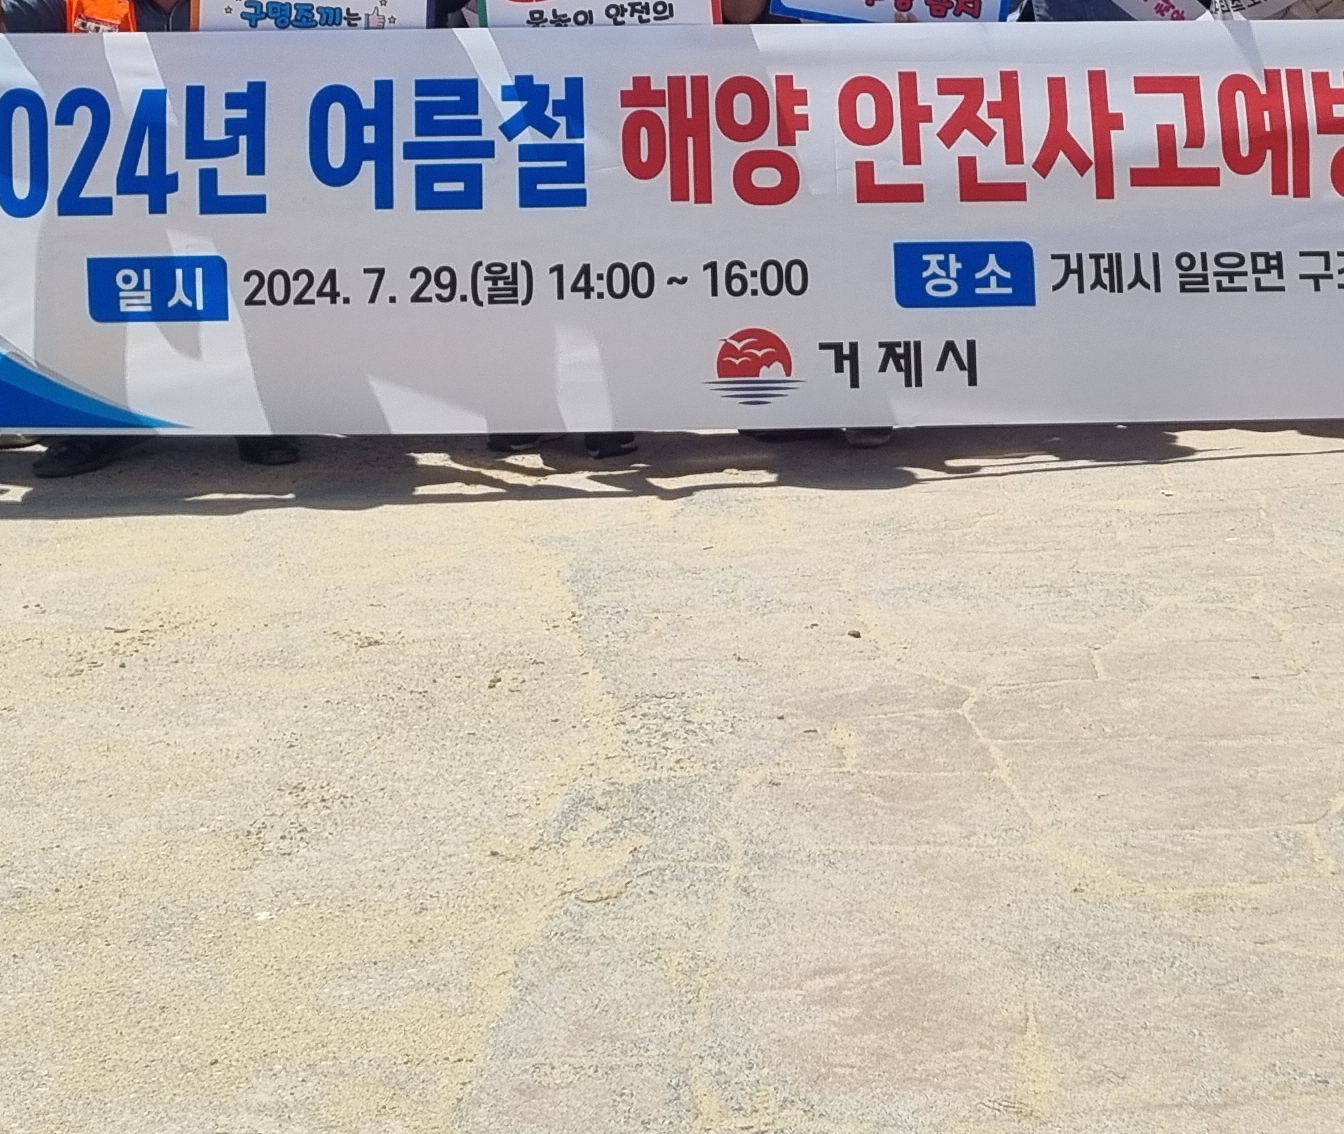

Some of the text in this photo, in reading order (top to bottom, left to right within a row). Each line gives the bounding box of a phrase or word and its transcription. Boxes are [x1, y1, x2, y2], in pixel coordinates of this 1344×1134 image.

[604, 0, 674, 26] 안전의
[309, 74, 588, 210] 여름철
[621, 74, 809, 205] 해양
[243, 268, 350, 307] 2024.
[364, 267, 397, 305] 7.
[409, 259, 534, 306] 29.(월)
[548, 261, 655, 301] 14:00
[703, 259, 808, 299] 16:00
[1050, 252, 1162, 295] 거제시
[1177, 250, 1287, 293] 일운면
